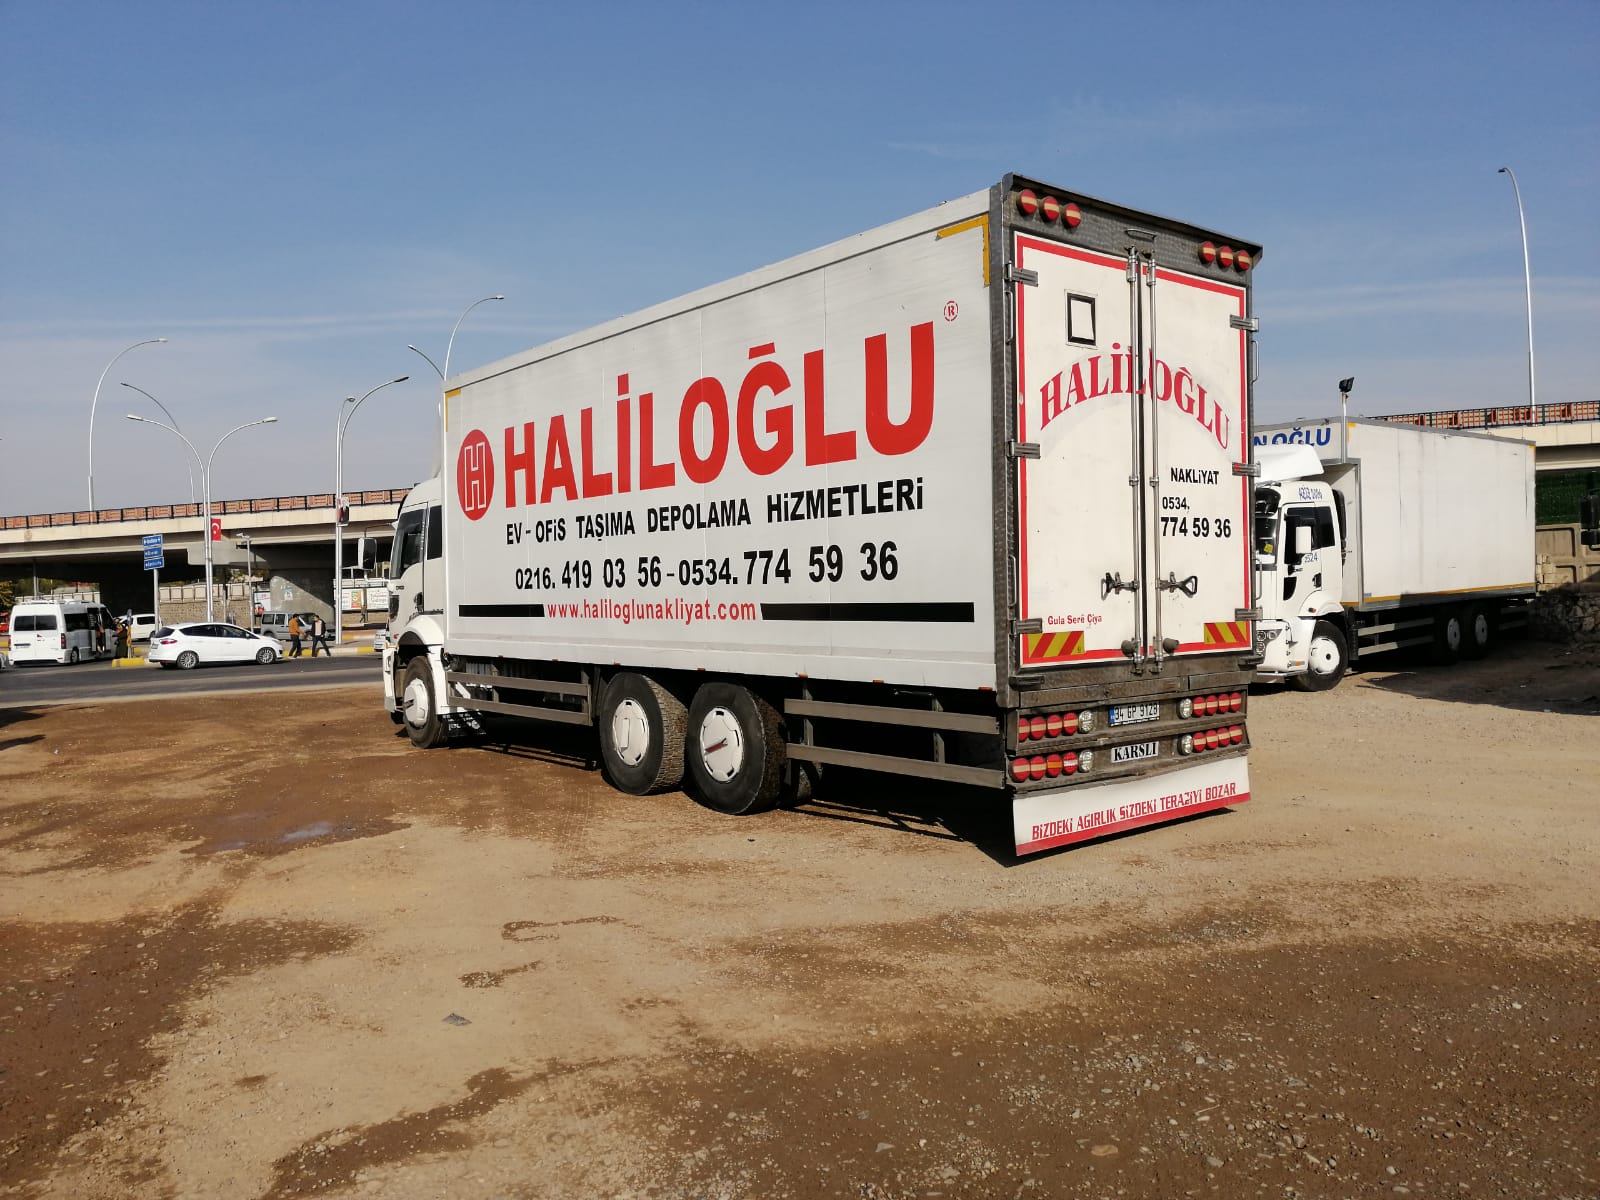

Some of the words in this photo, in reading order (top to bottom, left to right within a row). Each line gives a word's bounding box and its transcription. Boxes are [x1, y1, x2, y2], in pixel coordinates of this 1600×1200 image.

[576, 510, 636, 541] TAŞIMA
[647, 498, 751, 533] DEPOLAMA
[1160, 516, 1188, 537] 774
[1192, 517, 1210, 538] 59
[1214, 518, 1232, 538] 36
[603, 558, 626, 588] 03
[808, 544, 843, 583] 59
[860, 541, 898, 581] 36
[547, 598, 756, 625] www.haliloglunakliyat.com
[1047, 615, 1065, 625] Gula
[1114, 706, 1124, 721] 34
[1113, 742, 1157, 762] KARSLI
[1205, 782, 1236, 801] BOZAR
